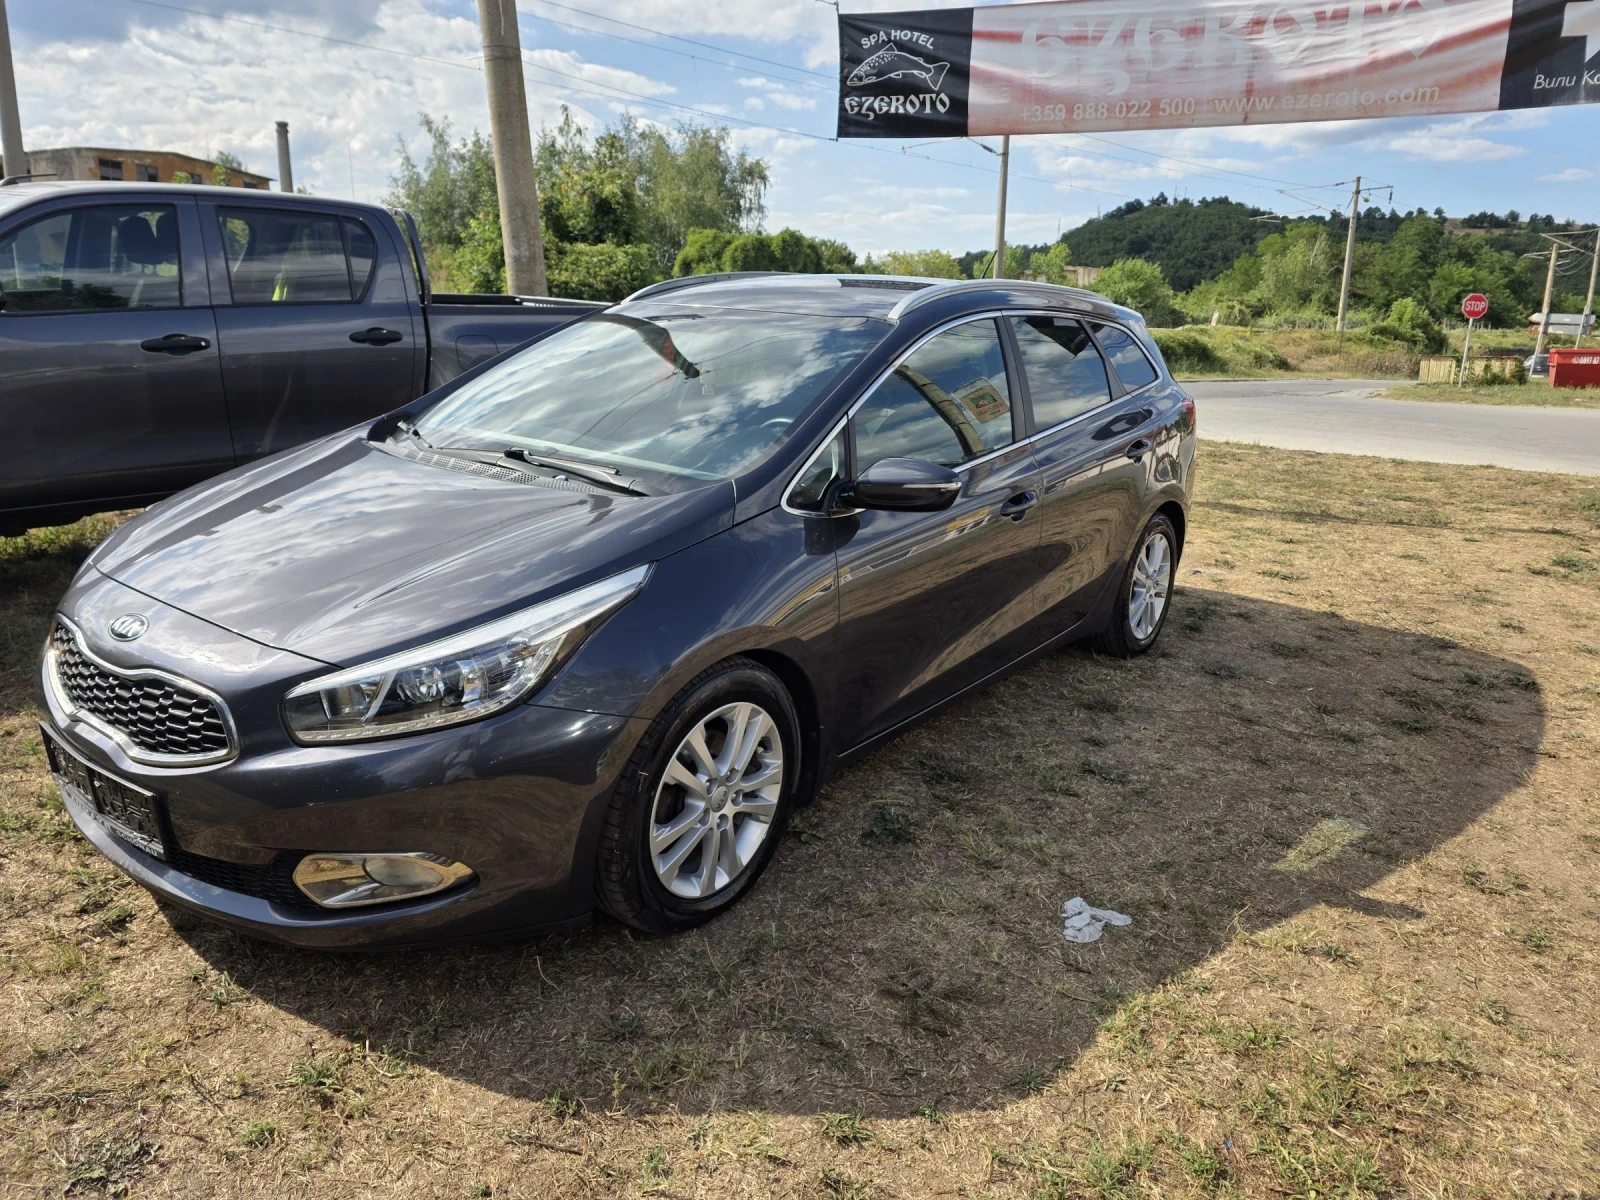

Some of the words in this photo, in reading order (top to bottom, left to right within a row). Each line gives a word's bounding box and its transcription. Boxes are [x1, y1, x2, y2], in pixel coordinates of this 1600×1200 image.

[861, 30, 888, 49] SPA
[891, 29, 935, 50] HOTEL
[1533, 74, 1577, 90] Вили
[844, 92, 950, 120] EZEROTO
[1020, 104, 1066, 121] +359
[1072, 102, 1108, 120] 888
[1115, 100, 1151, 118] 022
[1159, 98, 1196, 116] 500
[1214, 86, 1440, 113] www.ezeroto.com
[1465, 301, 1486, 311] STOP
